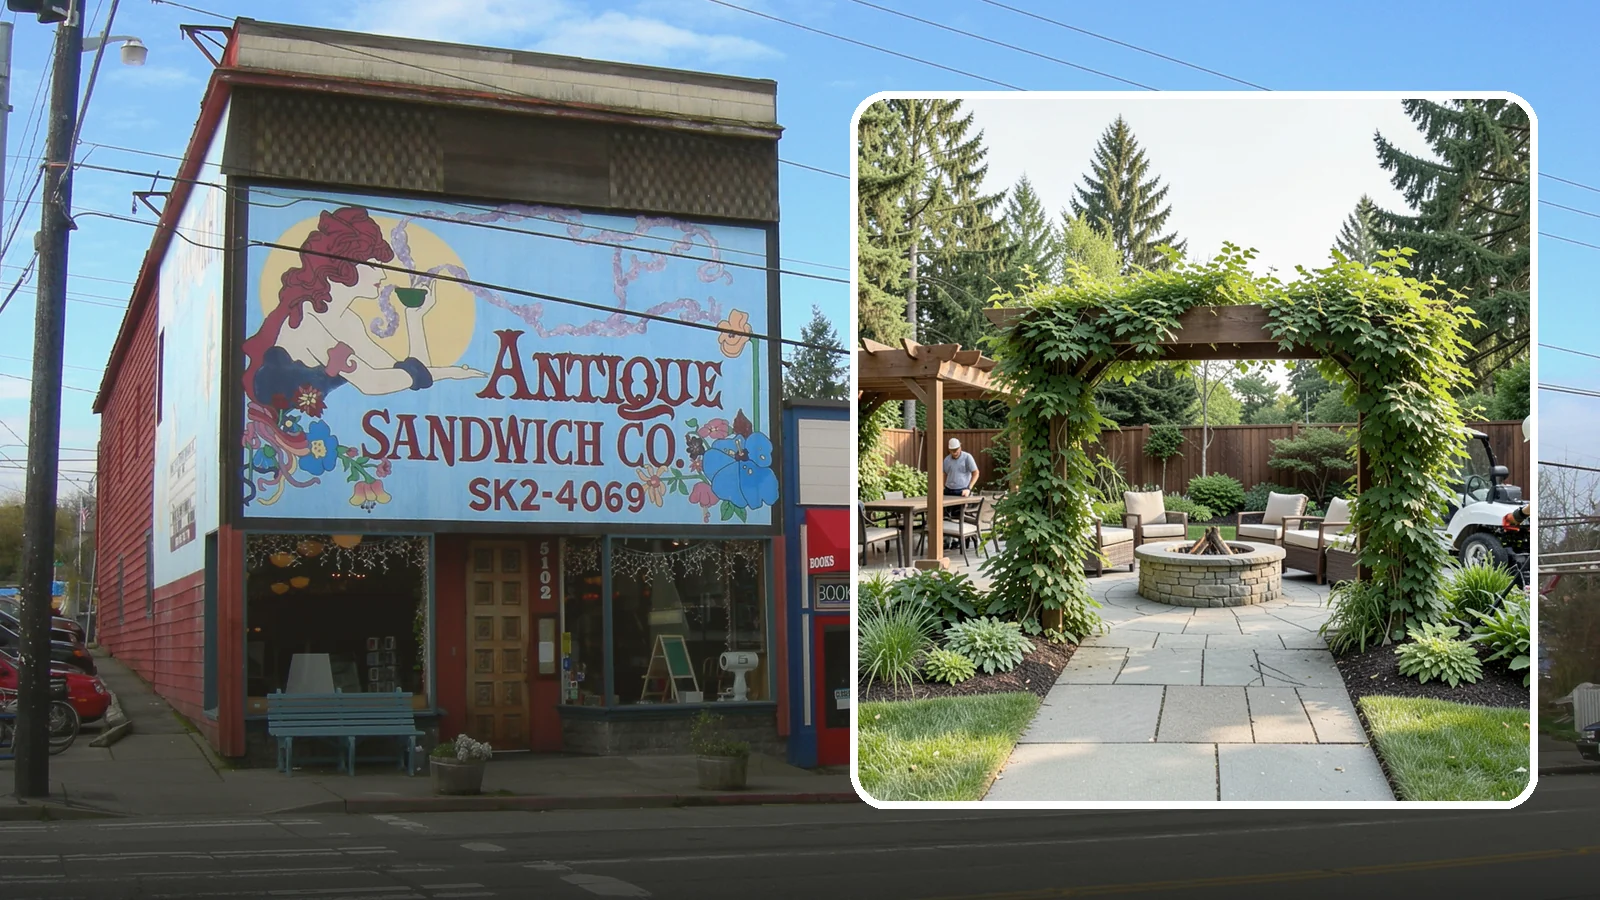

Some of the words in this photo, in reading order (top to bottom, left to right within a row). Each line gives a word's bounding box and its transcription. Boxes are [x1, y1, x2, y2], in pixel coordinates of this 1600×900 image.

[475, 328, 724, 421] ANTIQUE
[361, 408, 605, 467] SANDWICH
[617, 421, 685, 469] CO.
[469, 477, 646, 513] SK2-4069
[540, 541, 551, 600] 5102
[809, 555, 835, 569] BOOKS
